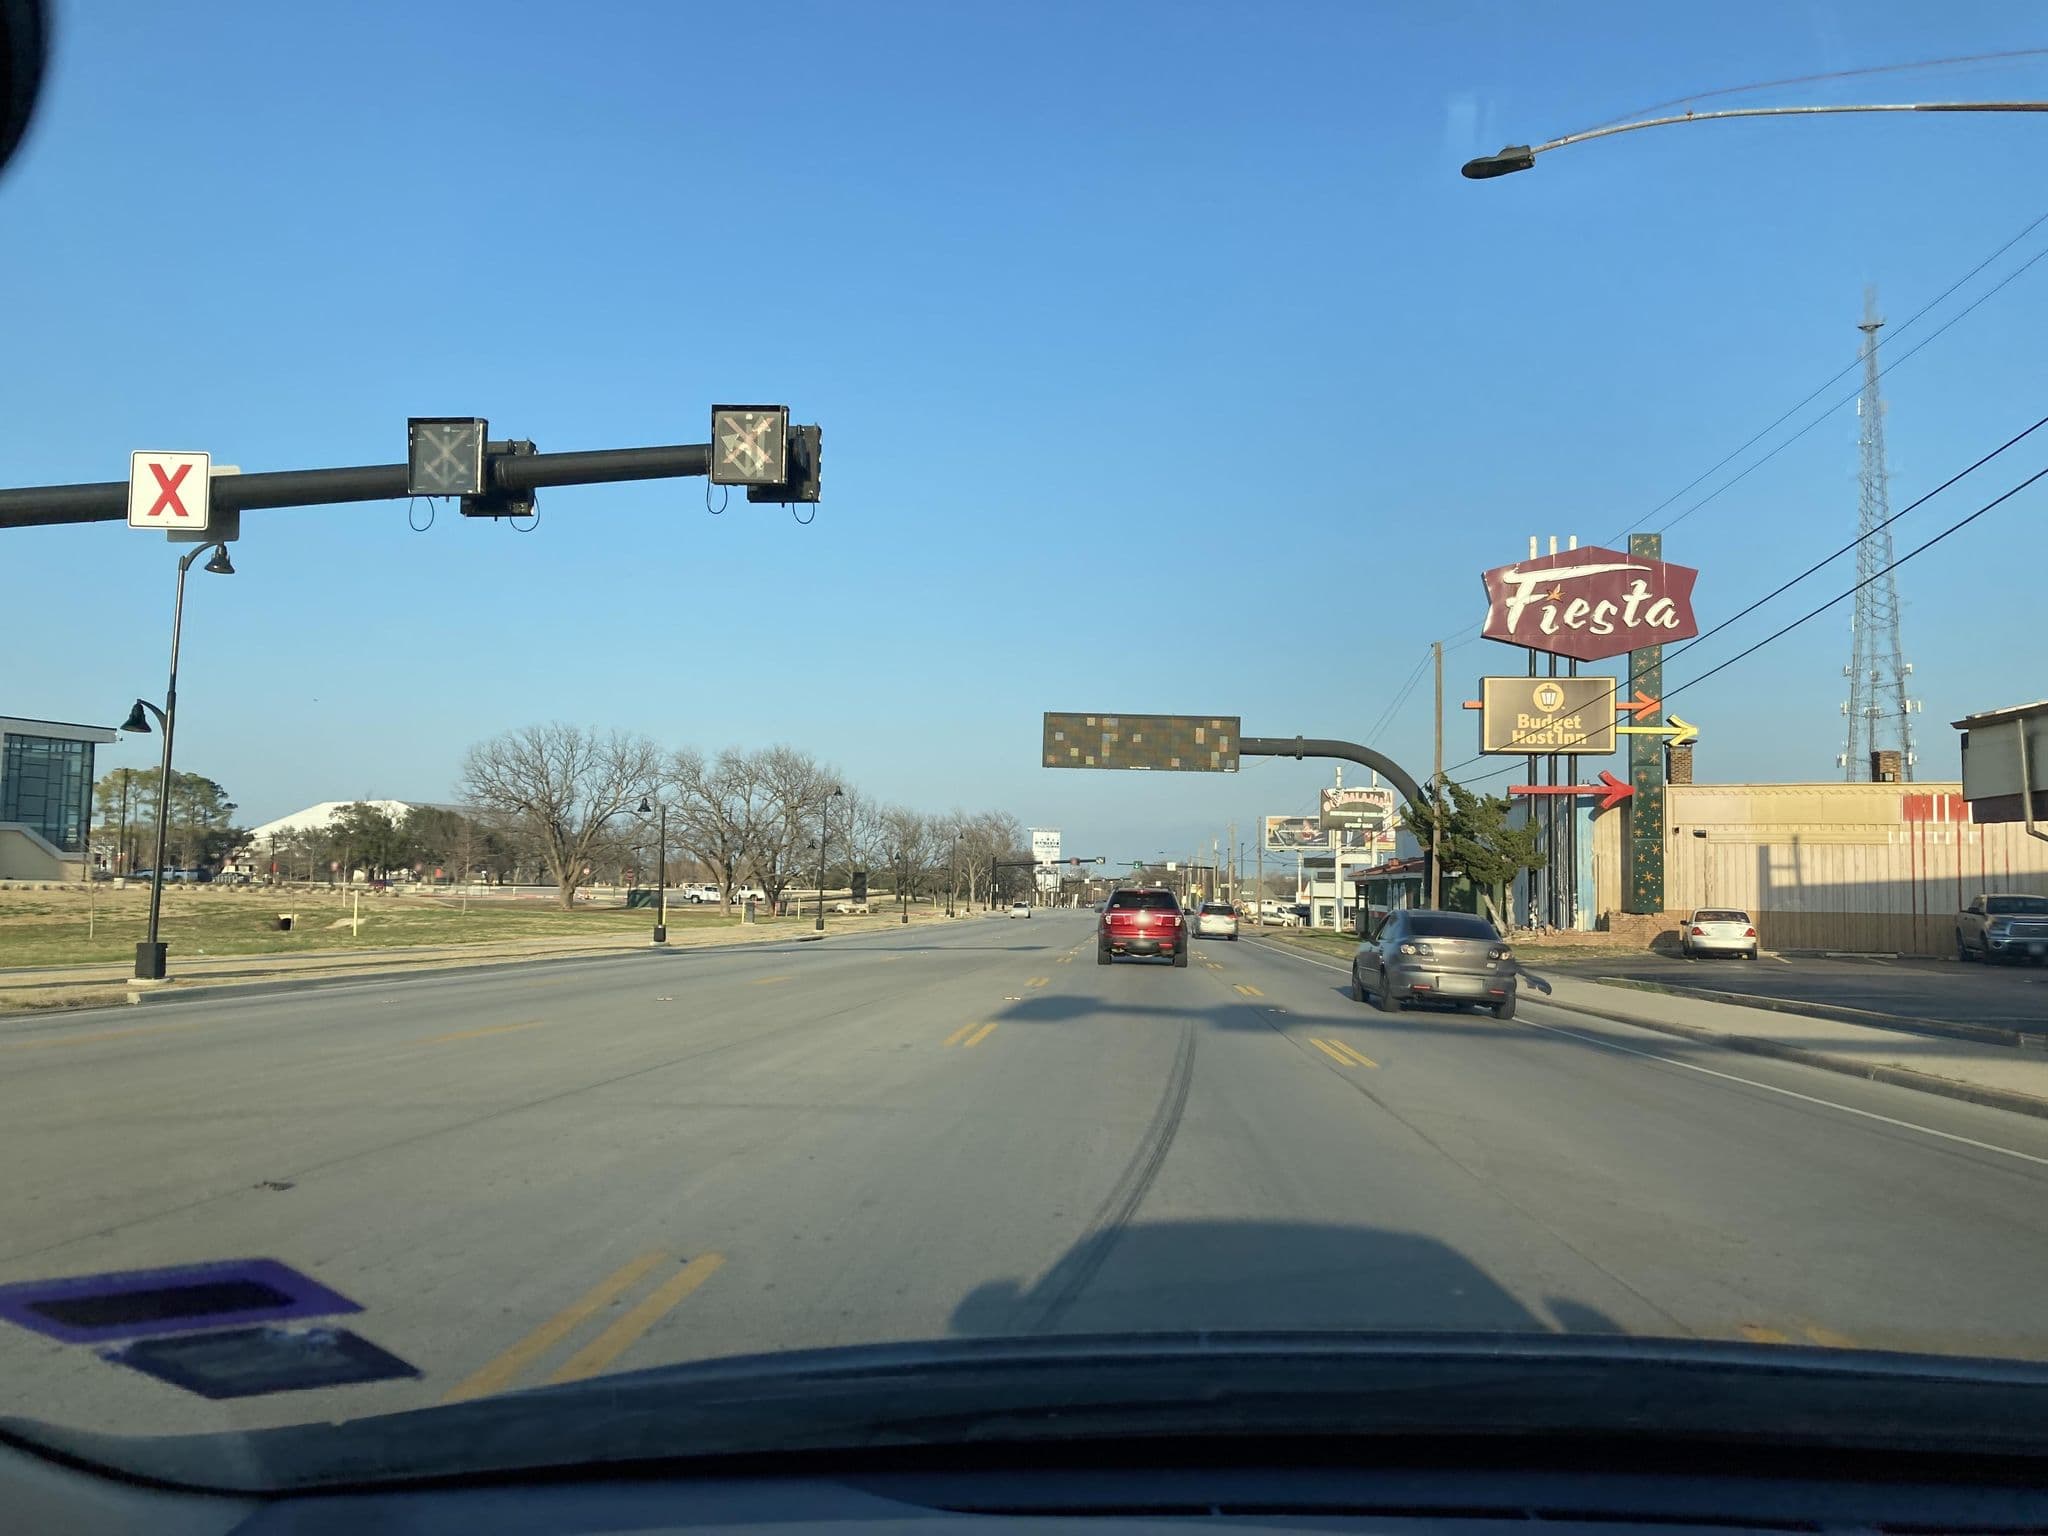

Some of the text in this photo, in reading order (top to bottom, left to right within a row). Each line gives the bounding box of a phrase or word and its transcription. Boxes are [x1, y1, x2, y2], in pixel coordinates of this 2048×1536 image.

[148, 464, 192, 516] X
[1503, 564, 1680, 635] Fiesta
[1511, 729, 1588, 745] Host Inn
[1517, 713, 1582, 733] Budget
